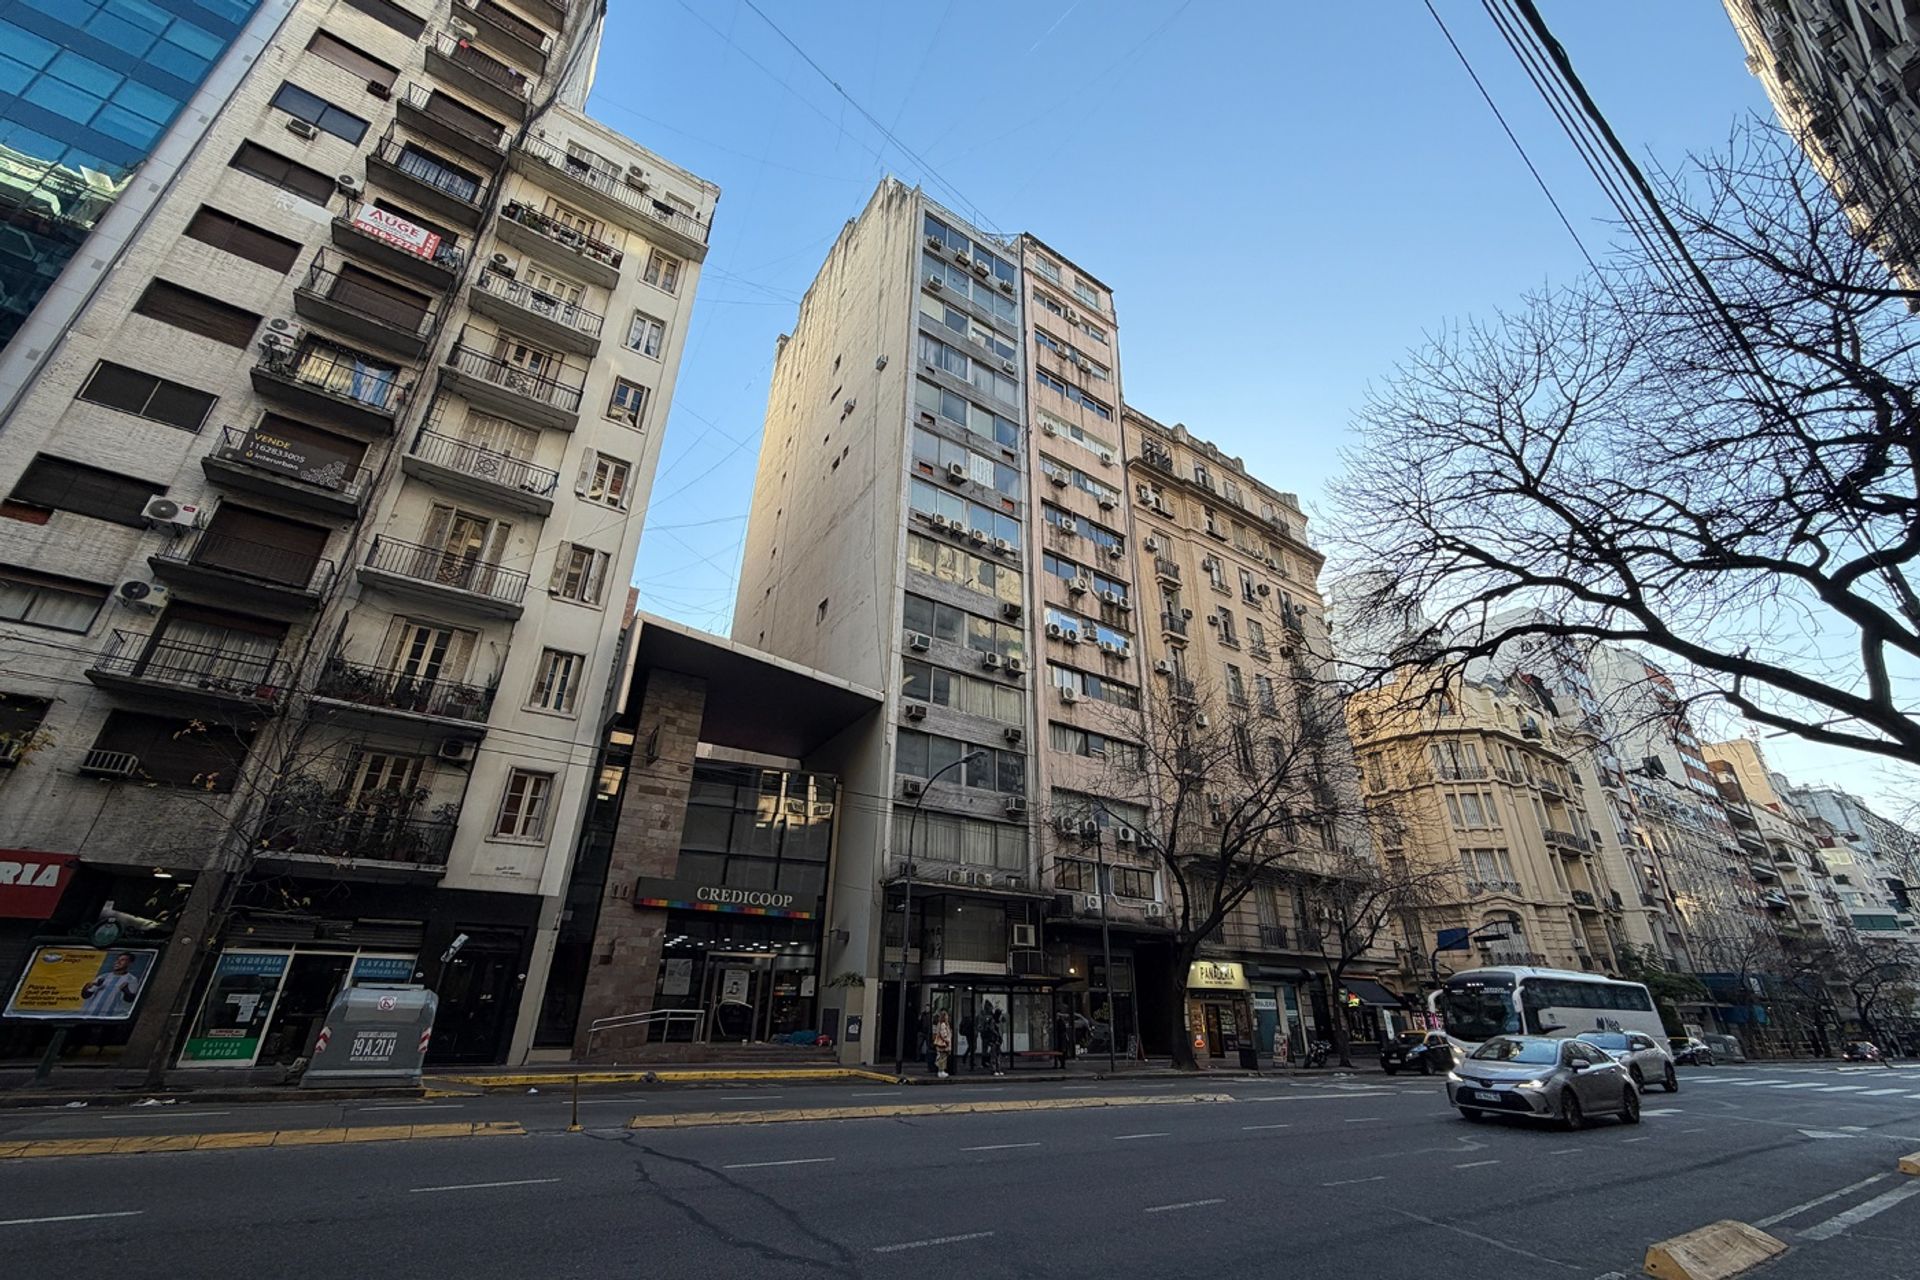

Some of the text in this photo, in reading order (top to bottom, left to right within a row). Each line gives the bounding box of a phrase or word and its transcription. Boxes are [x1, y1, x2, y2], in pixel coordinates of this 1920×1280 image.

[369, 210, 421, 237] AUGE
[254, 432, 292, 450] VENDE
[249, 441, 306, 464] 1162833005
[697, 886, 793, 907] CREDICOOP
[351, 1038, 365, 1056] 19
[363, 1039, 373, 1056] A
